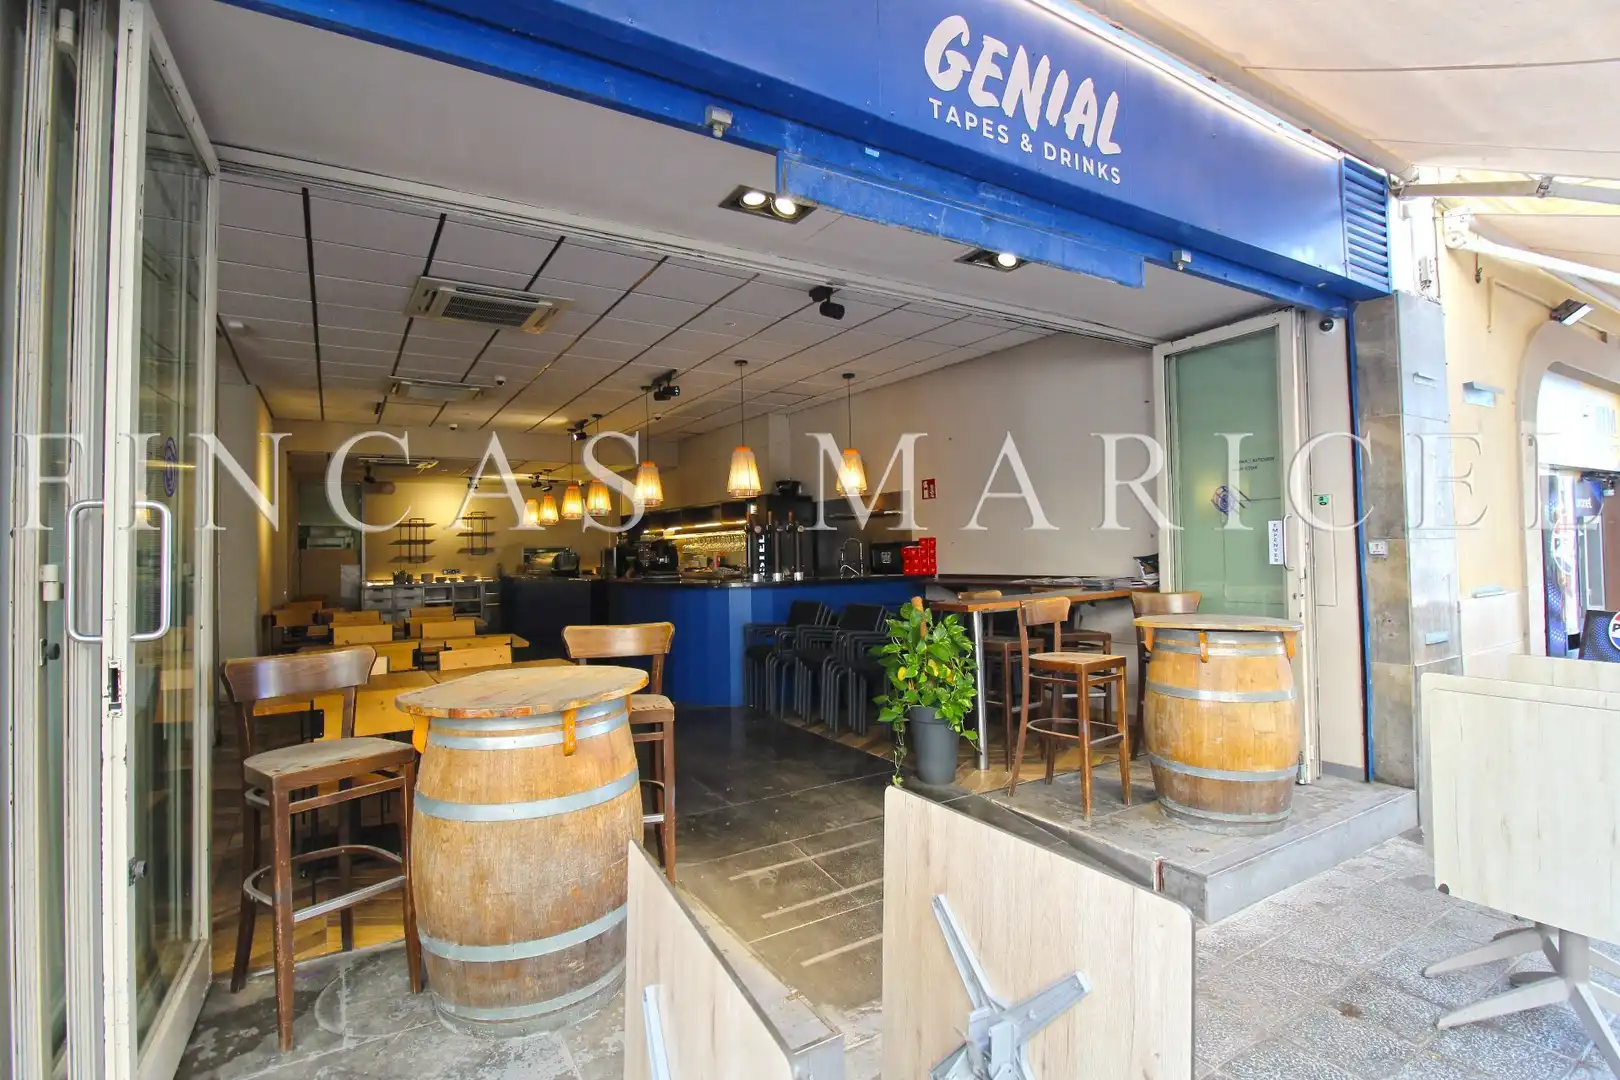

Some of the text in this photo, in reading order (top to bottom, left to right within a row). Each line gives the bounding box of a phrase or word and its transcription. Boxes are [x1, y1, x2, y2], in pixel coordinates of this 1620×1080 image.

[924, 14, 1122, 155] GENIAL
[928, 97, 1121, 185] TAPES & DRINKS
